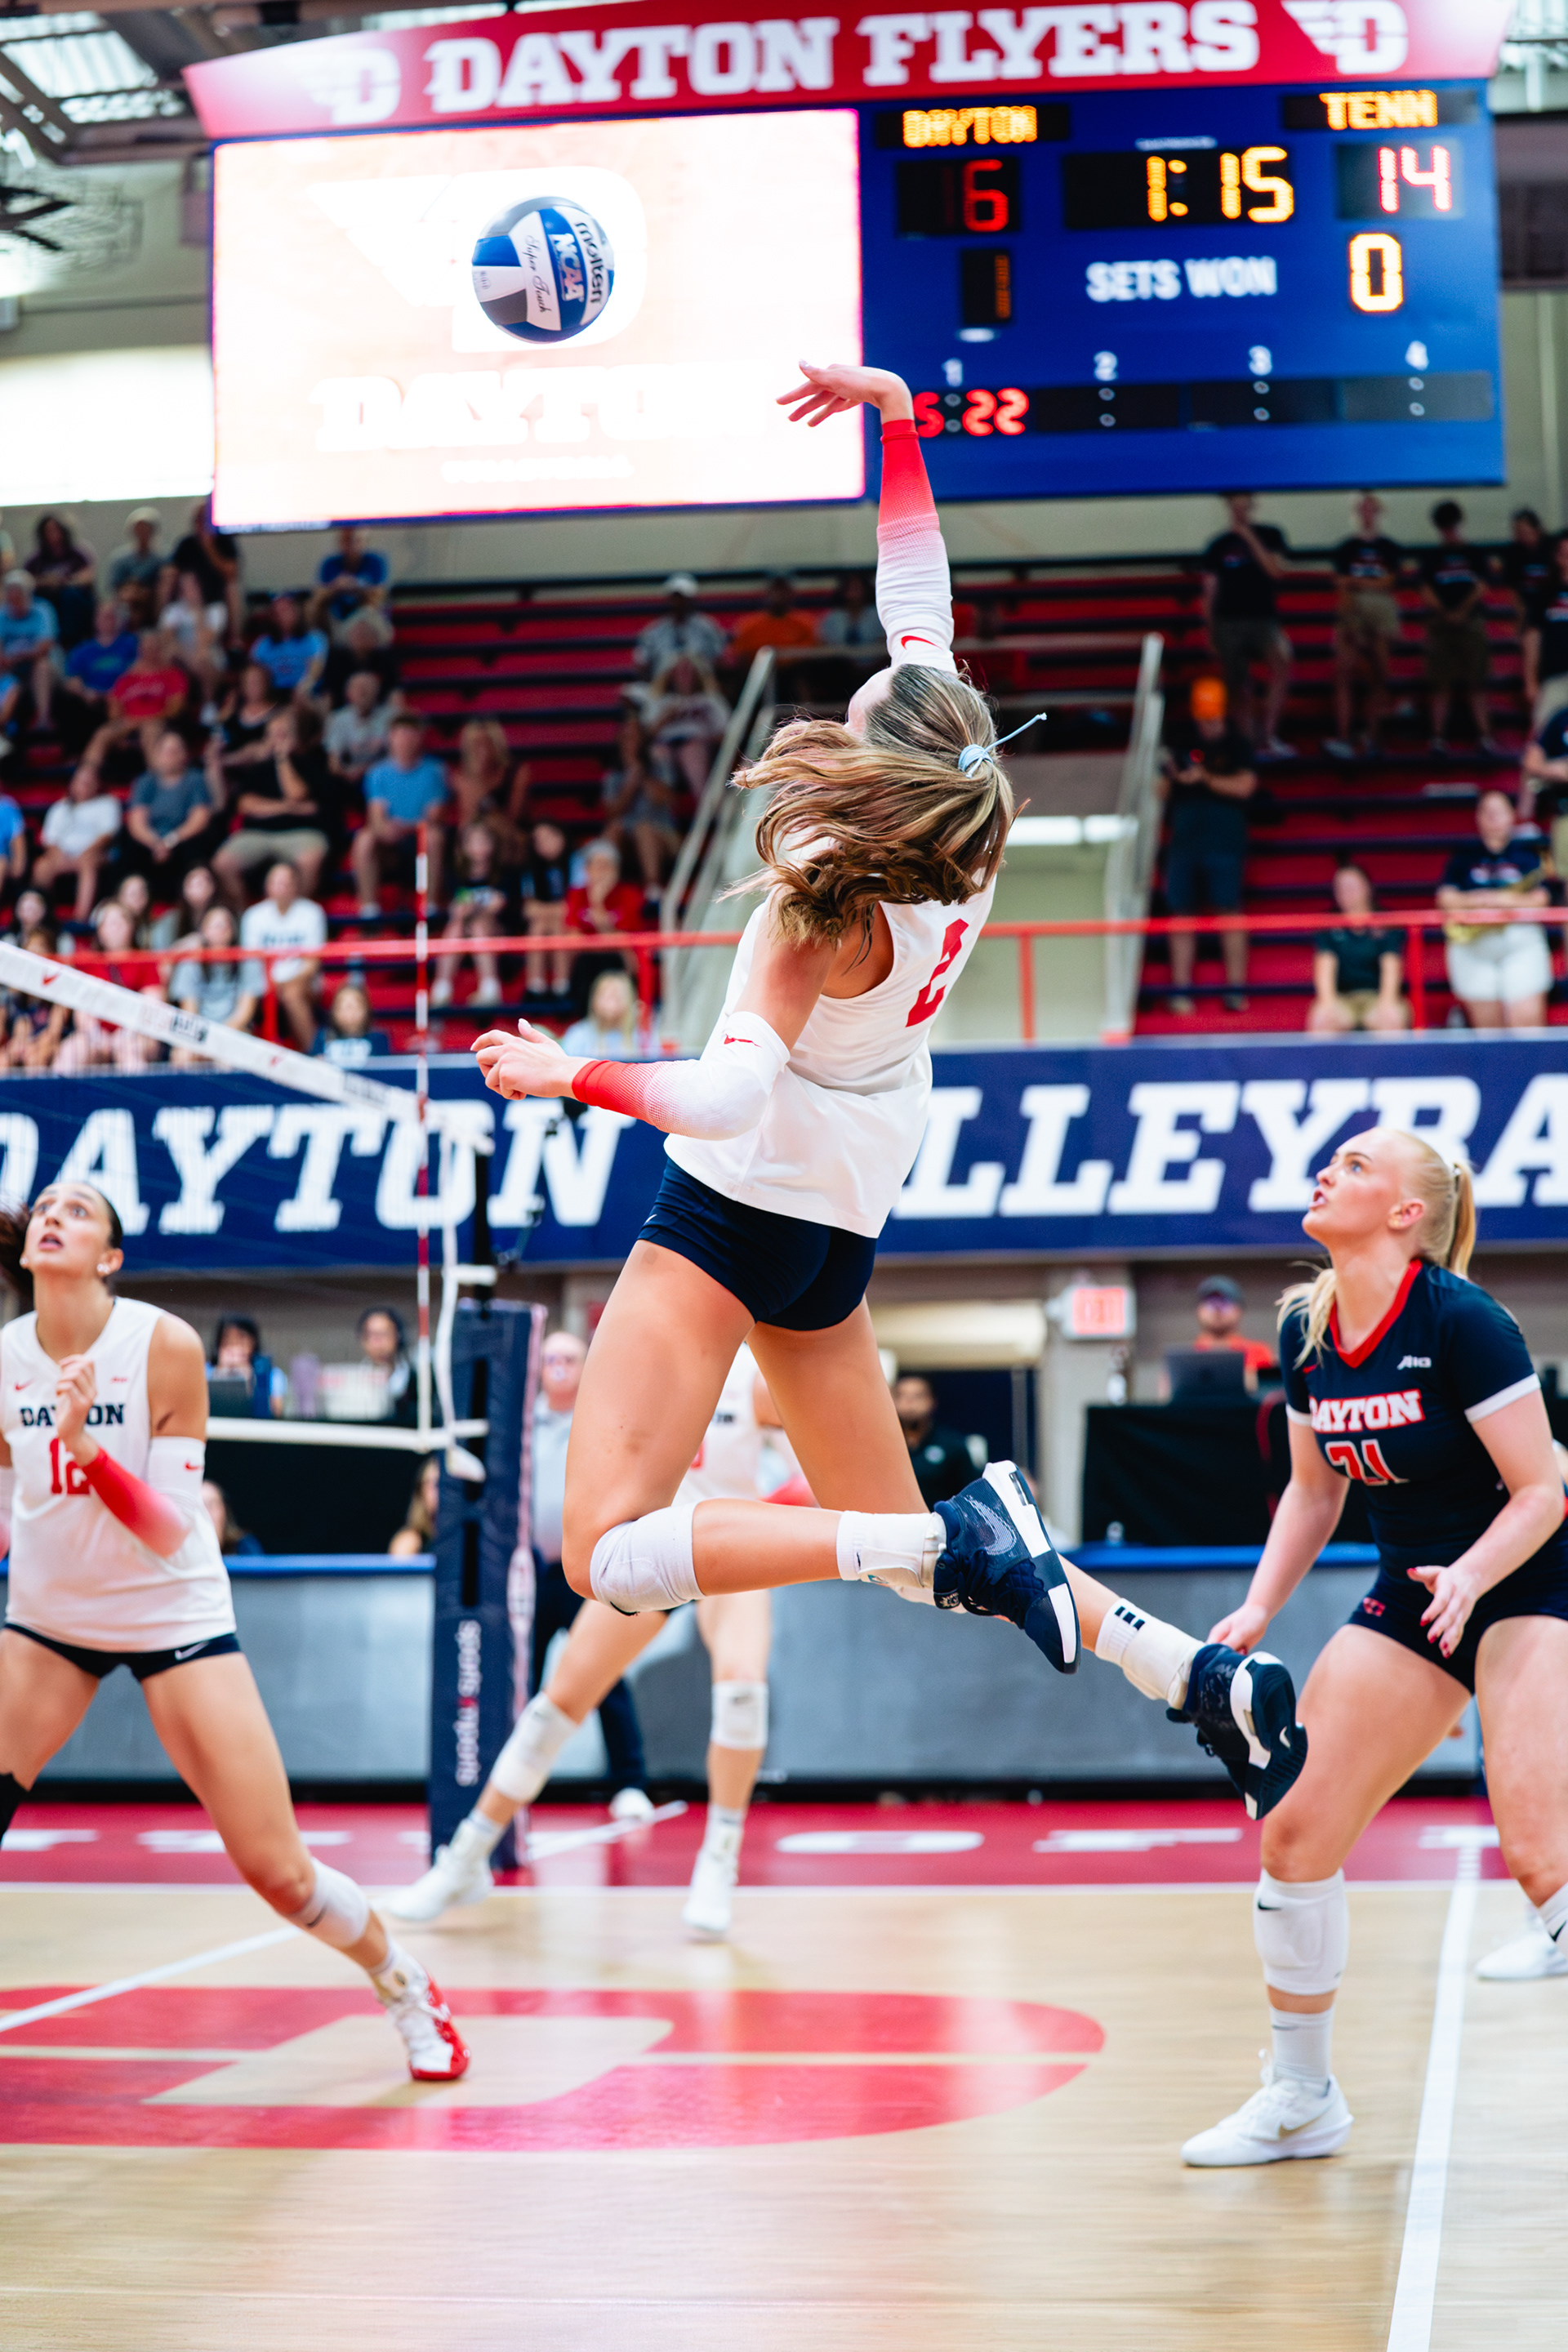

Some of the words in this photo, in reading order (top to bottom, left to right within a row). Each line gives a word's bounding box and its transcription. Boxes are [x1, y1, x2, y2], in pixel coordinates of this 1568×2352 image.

[423, 16, 840, 114] DAYTON
[855, 1, 1260, 87] FLYERS
[903, 105, 1038, 148] DAYTON
[1319, 90, 1438, 131] TENN
[1147, 146, 1294, 223] 1:15
[1378, 145, 1452, 214] 14
[523, 234, 543, 273] Super
[546, 233, 586, 303] NCAA
[574, 222, 604, 304] molten
[1349, 234, 1403, 313] 0
[532, 274, 553, 314] Touch
[1085, 261, 1183, 303] SETS
[1184, 256, 1278, 298] WON
[942, 358, 964, 388] 1
[1094, 350, 1119, 381] 2
[1248, 345, 1272, 376] 3
[307, 362, 772, 452] DAYTO
[892, 1071, 1568, 1219] LLEYBA
[20, 1403, 126, 1427] DAON
